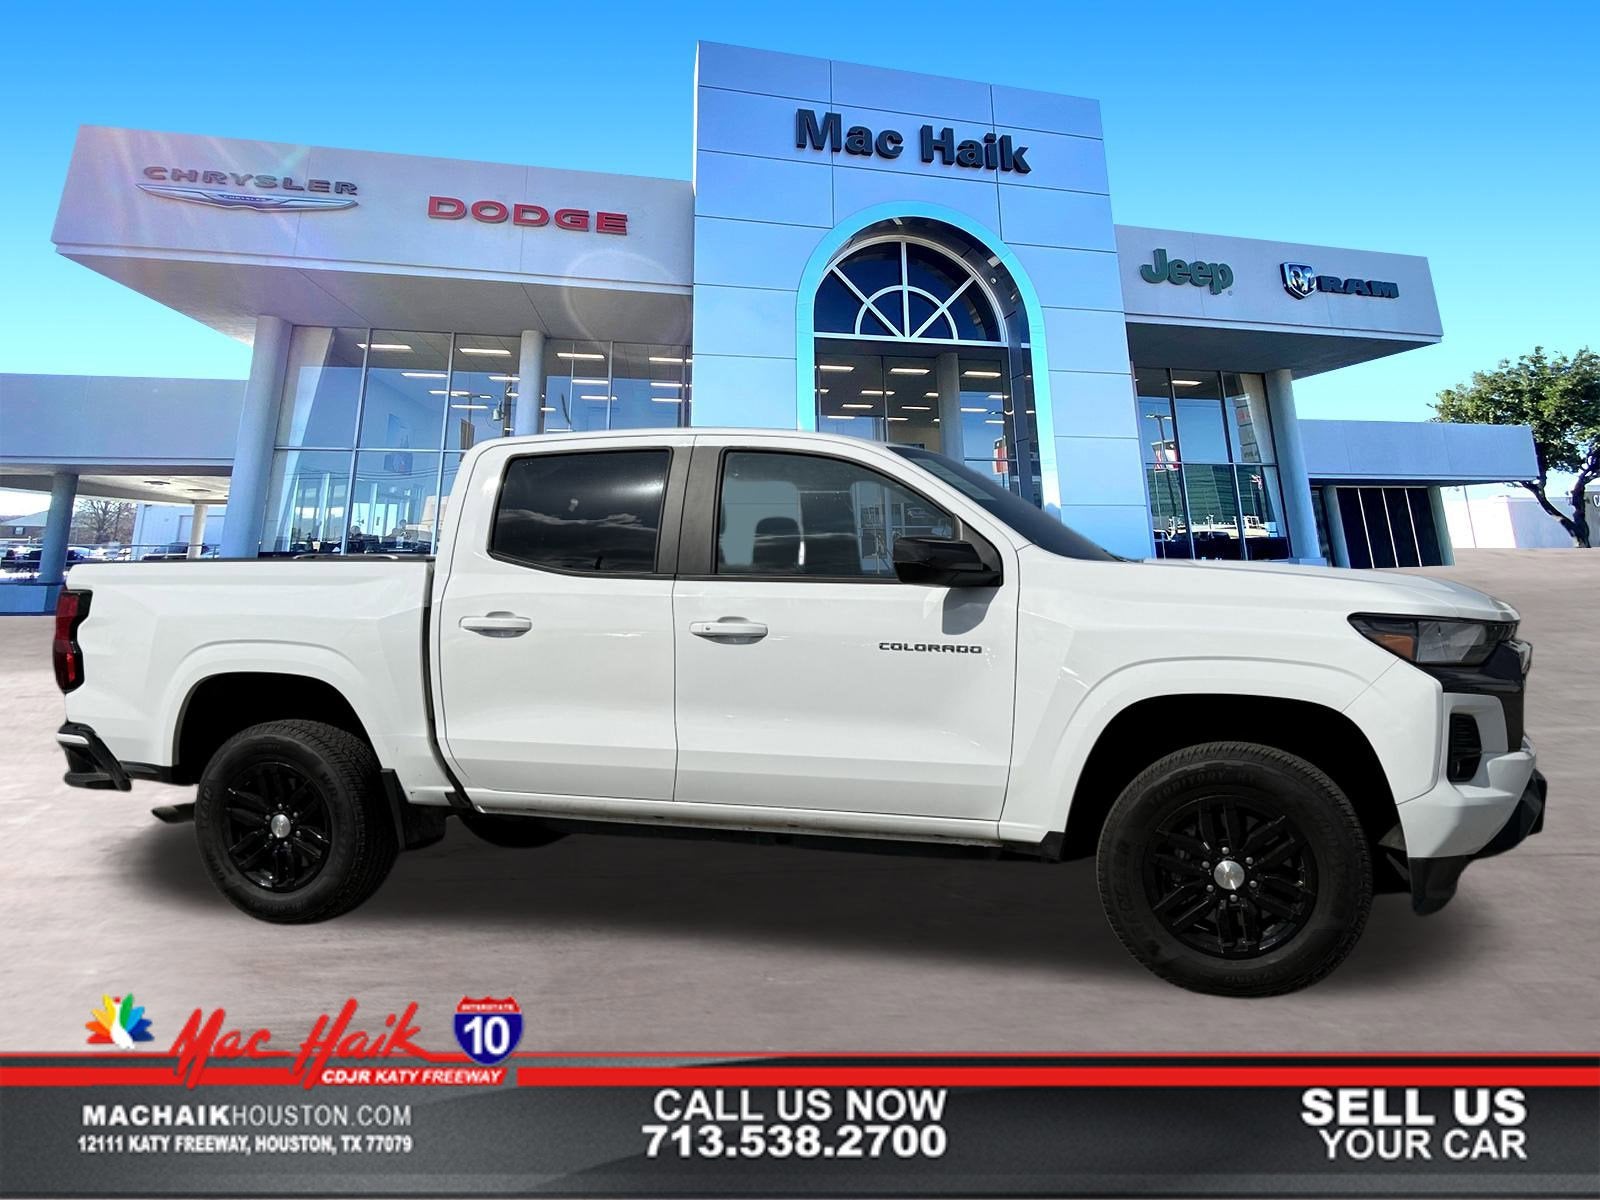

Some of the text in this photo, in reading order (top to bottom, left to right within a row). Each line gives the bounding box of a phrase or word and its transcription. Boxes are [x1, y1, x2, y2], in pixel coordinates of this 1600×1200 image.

[795, 108, 1032, 174] Mac Haik
[142, 166, 359, 196] CHRYSLER
[427, 196, 628, 235] DODGE
[1140, 248, 1234, 295] Jeep
[1316, 275, 1399, 298] RAM
[879, 642, 982, 654] COLORADO
